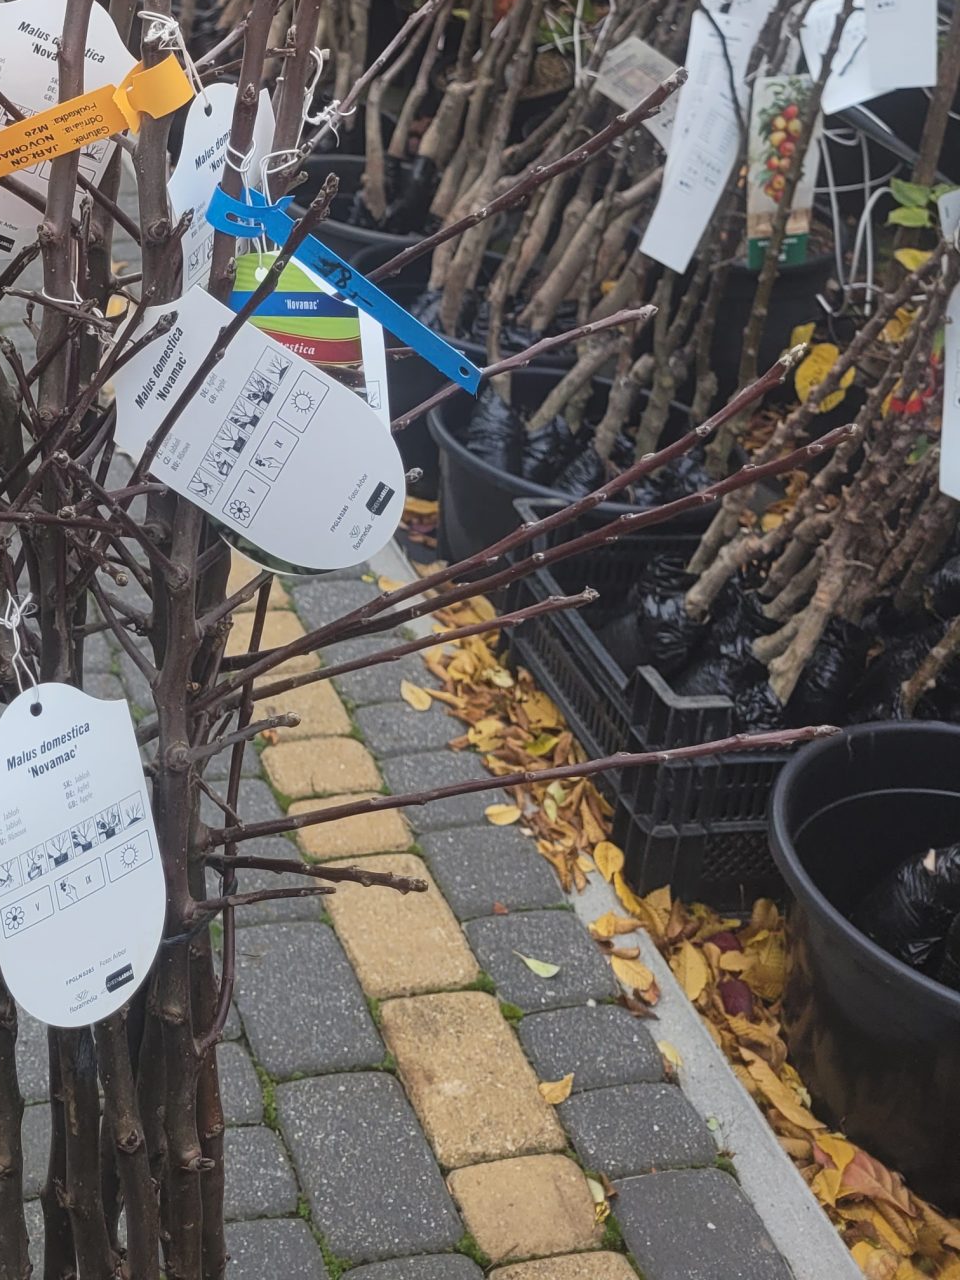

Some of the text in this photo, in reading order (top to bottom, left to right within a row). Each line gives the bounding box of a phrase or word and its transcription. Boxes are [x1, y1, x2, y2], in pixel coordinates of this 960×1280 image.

[18, 21, 50, 41] Malus
[71, 126, 110, 145] Gatunek:
[195, 146, 215, 170] Malus
[284, 298, 320, 310] 'Novamac'
[135, 327, 183, 410] Malus domestica
[155, 352, 186, 401] 'Novamac'
[200, 388, 209, 398] DE:
[208, 393, 218, 404] GB:
[163, 456, 171, 465] CZ:
[7, 723, 90, 771] Malus domestica
[28, 745, 77, 778] 'Novamac'
[35, 902, 39, 911] V
